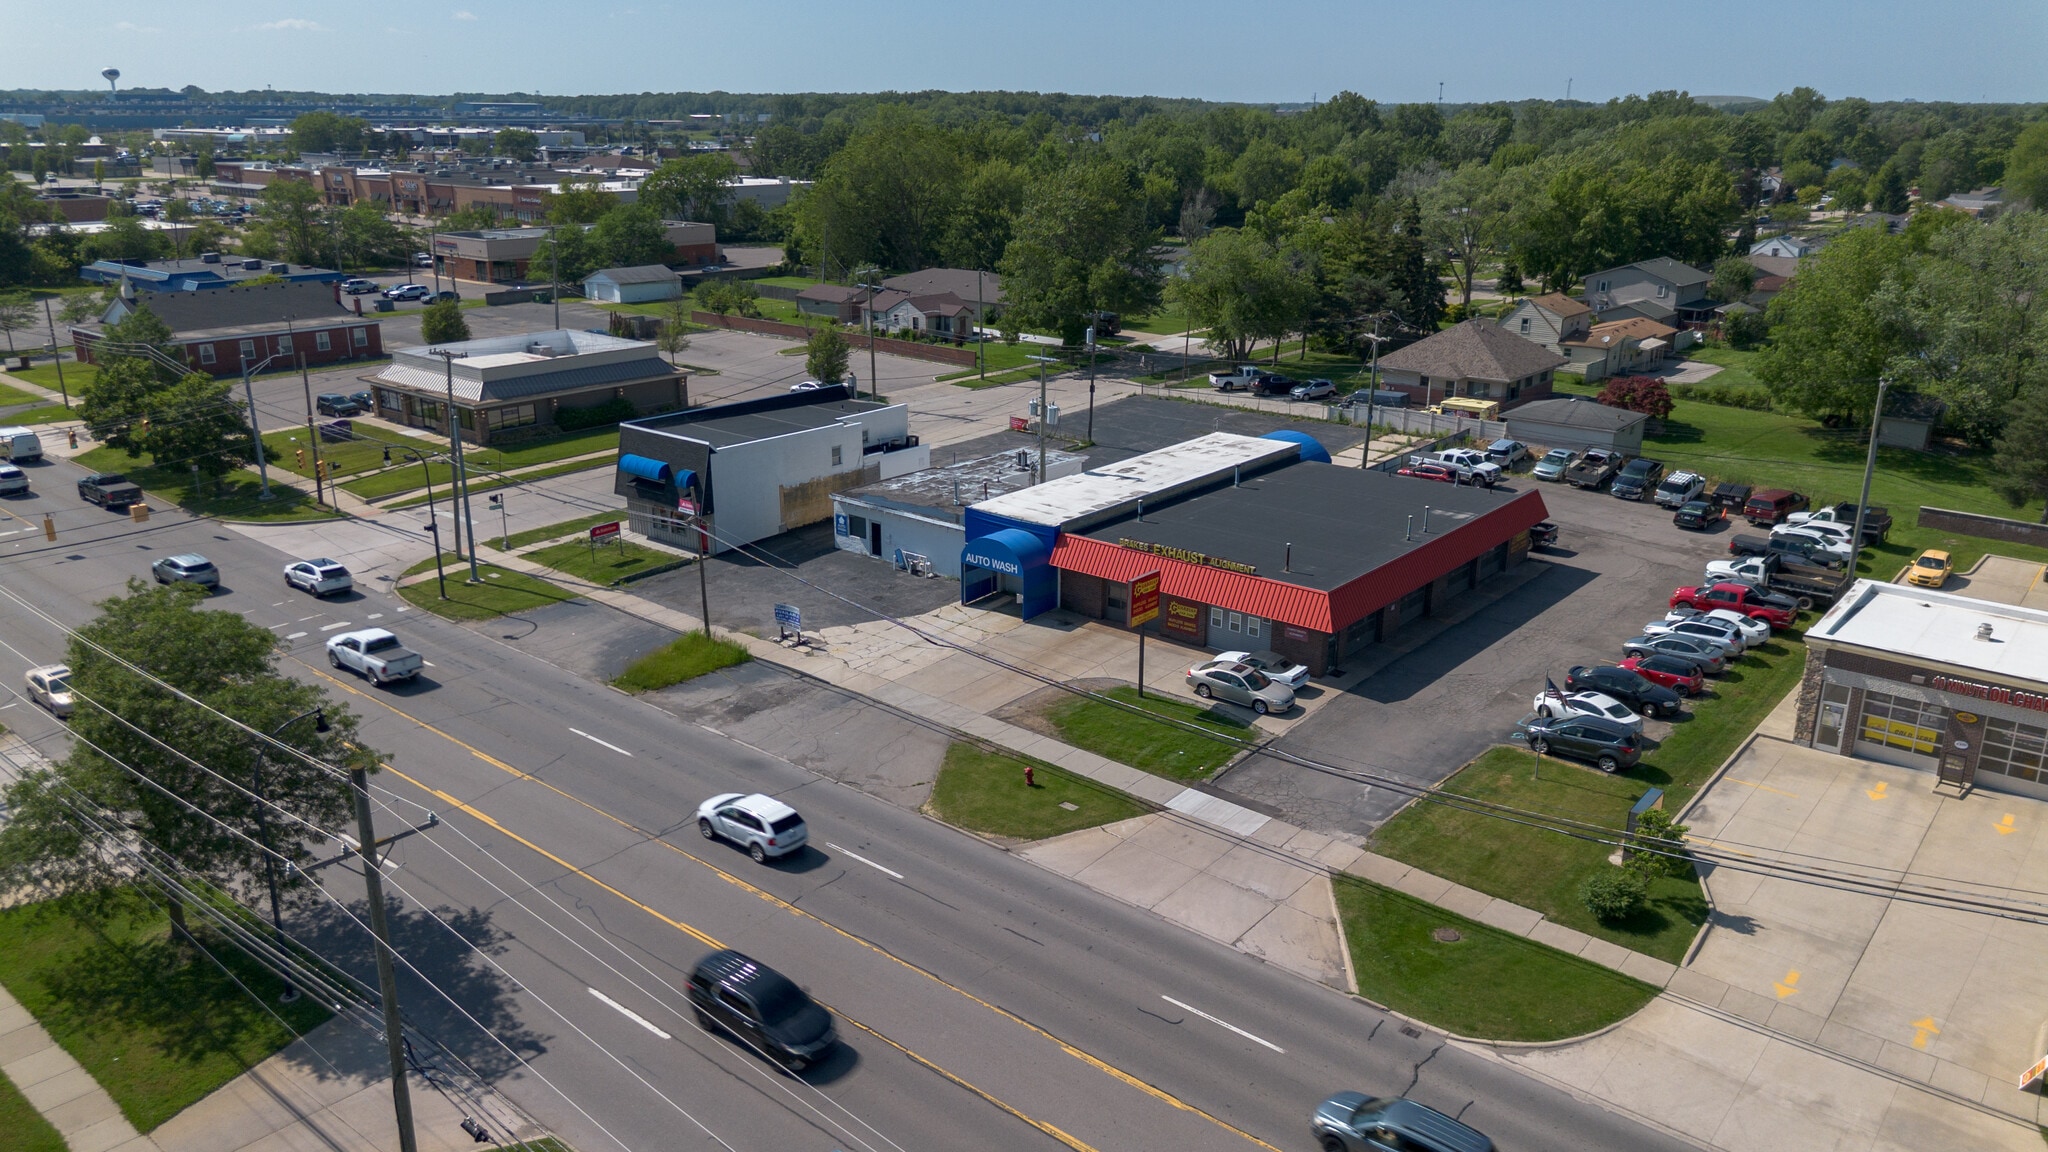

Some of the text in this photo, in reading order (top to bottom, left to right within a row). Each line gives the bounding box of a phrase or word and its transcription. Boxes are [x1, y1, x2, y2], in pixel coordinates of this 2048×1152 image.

[966, 552, 1018, 574] AUTO WASH
[1119, 537, 1257, 575] BRAKES EXHAUST ALIGNMENT
[1933, 675, 1946, 690] 10
[1947, 678, 1989, 700] MINUTE
[1990, 686, 2012, 705] OIL
